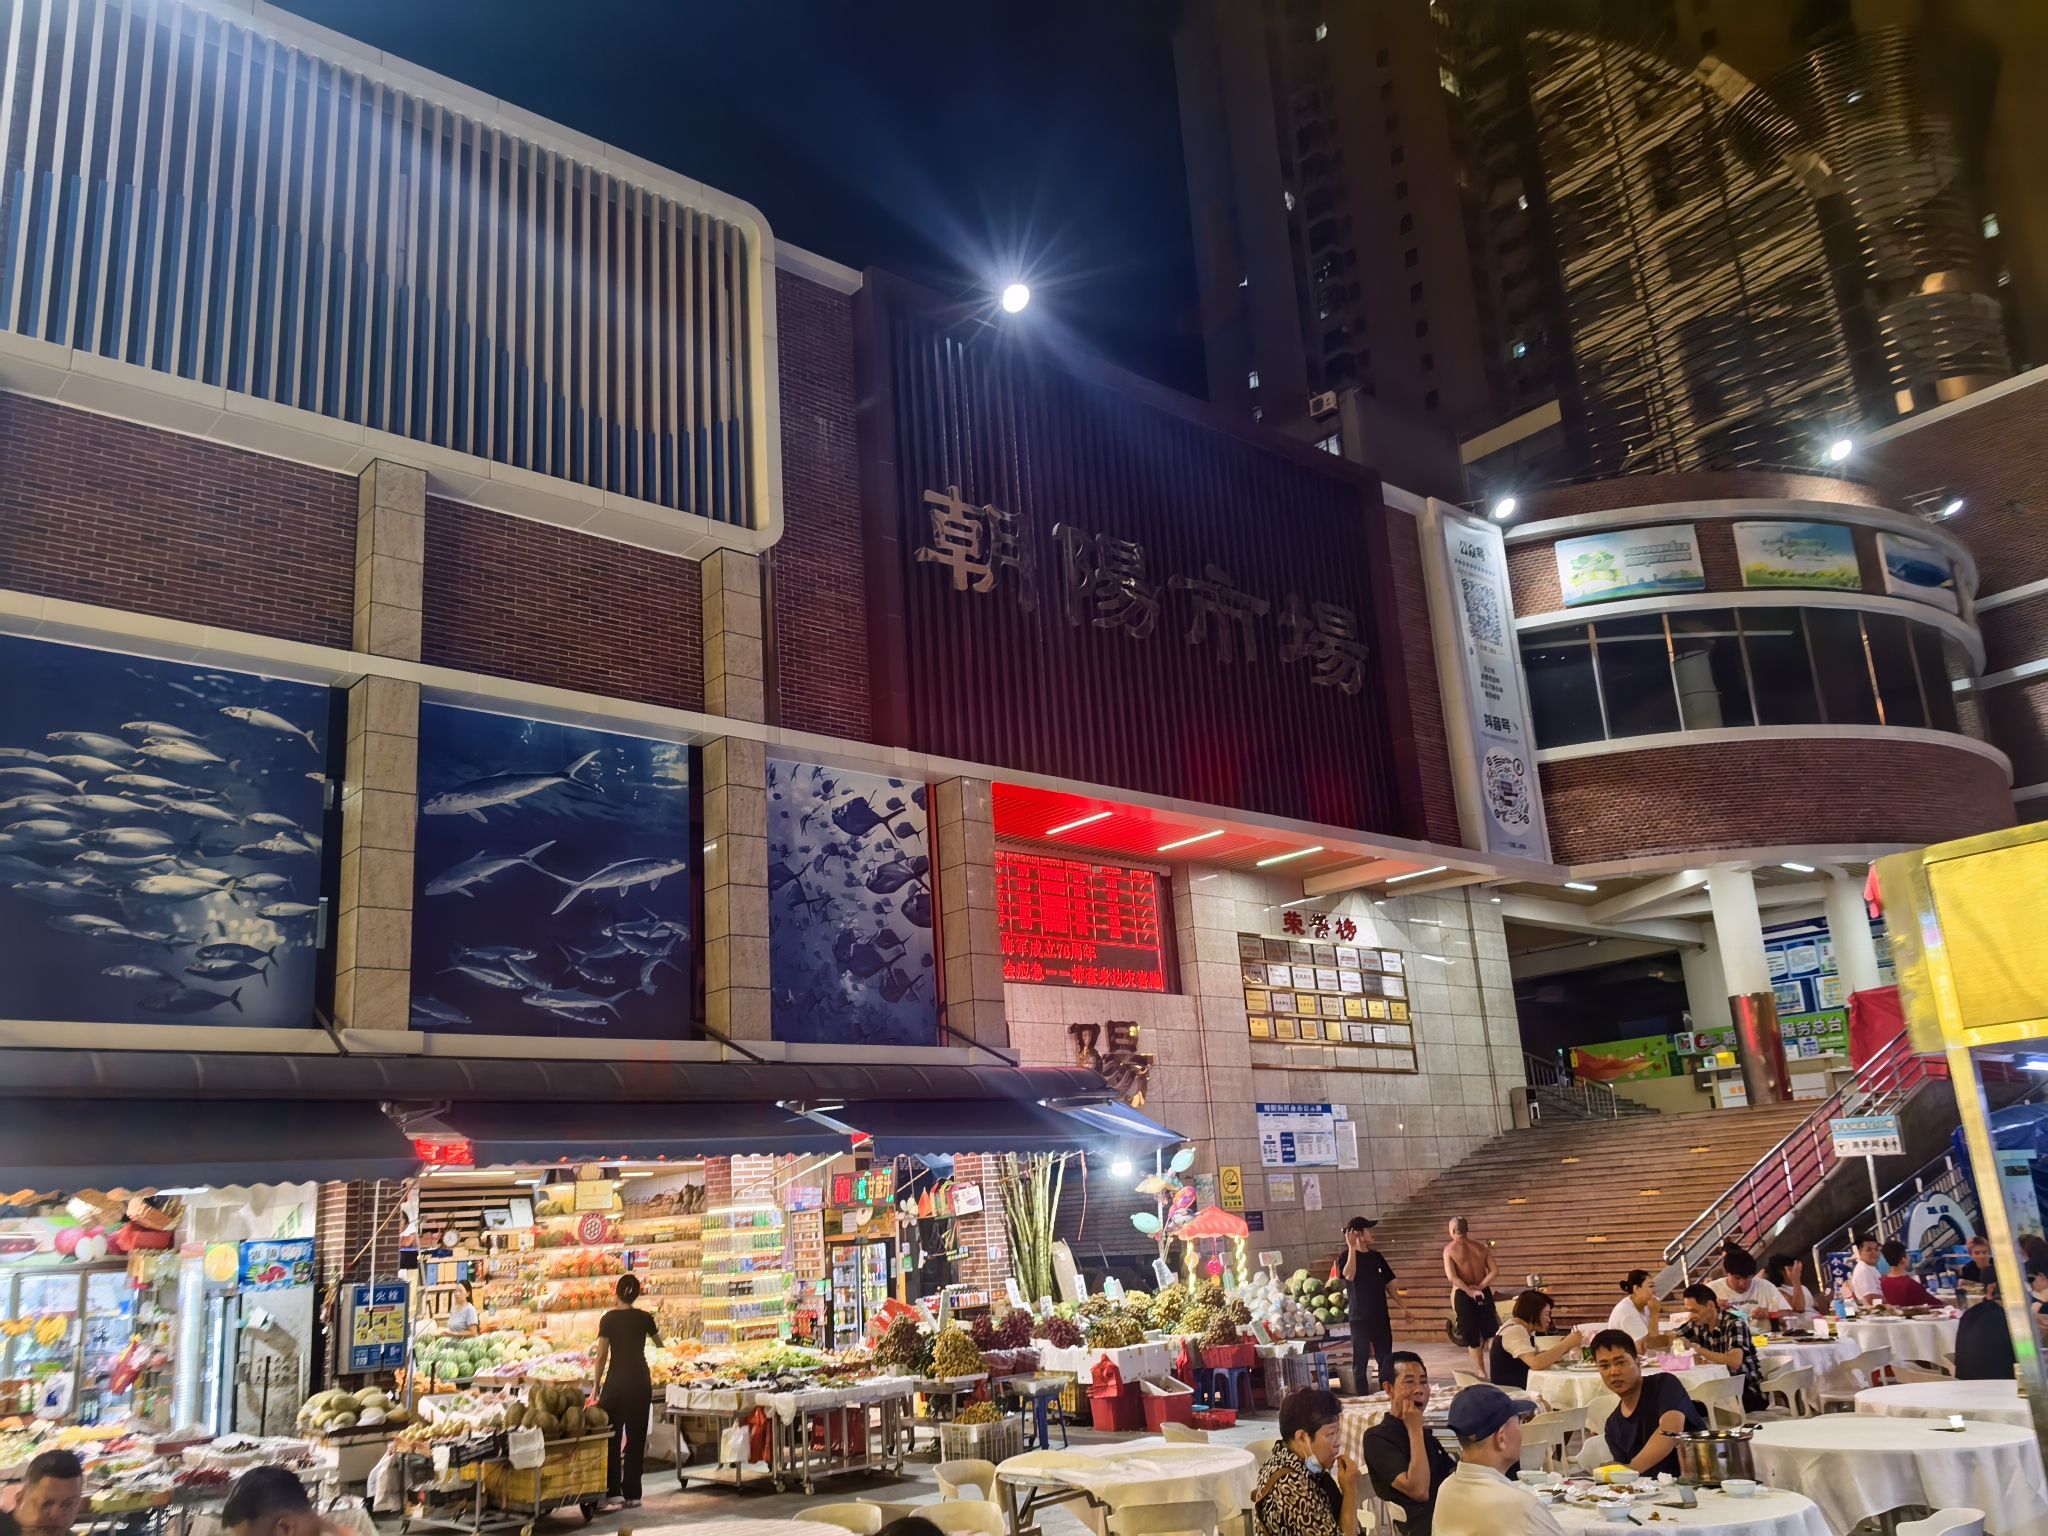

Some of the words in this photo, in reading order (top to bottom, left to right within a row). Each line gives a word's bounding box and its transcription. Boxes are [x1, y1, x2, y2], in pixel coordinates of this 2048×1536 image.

[1459, 540, 1486, 562] 公众号
[914, 485, 1370, 696] 朝陽市場
[1484, 713, 1511, 733] 抖音号
[1282, 910, 1357, 942] 荣誉榜
